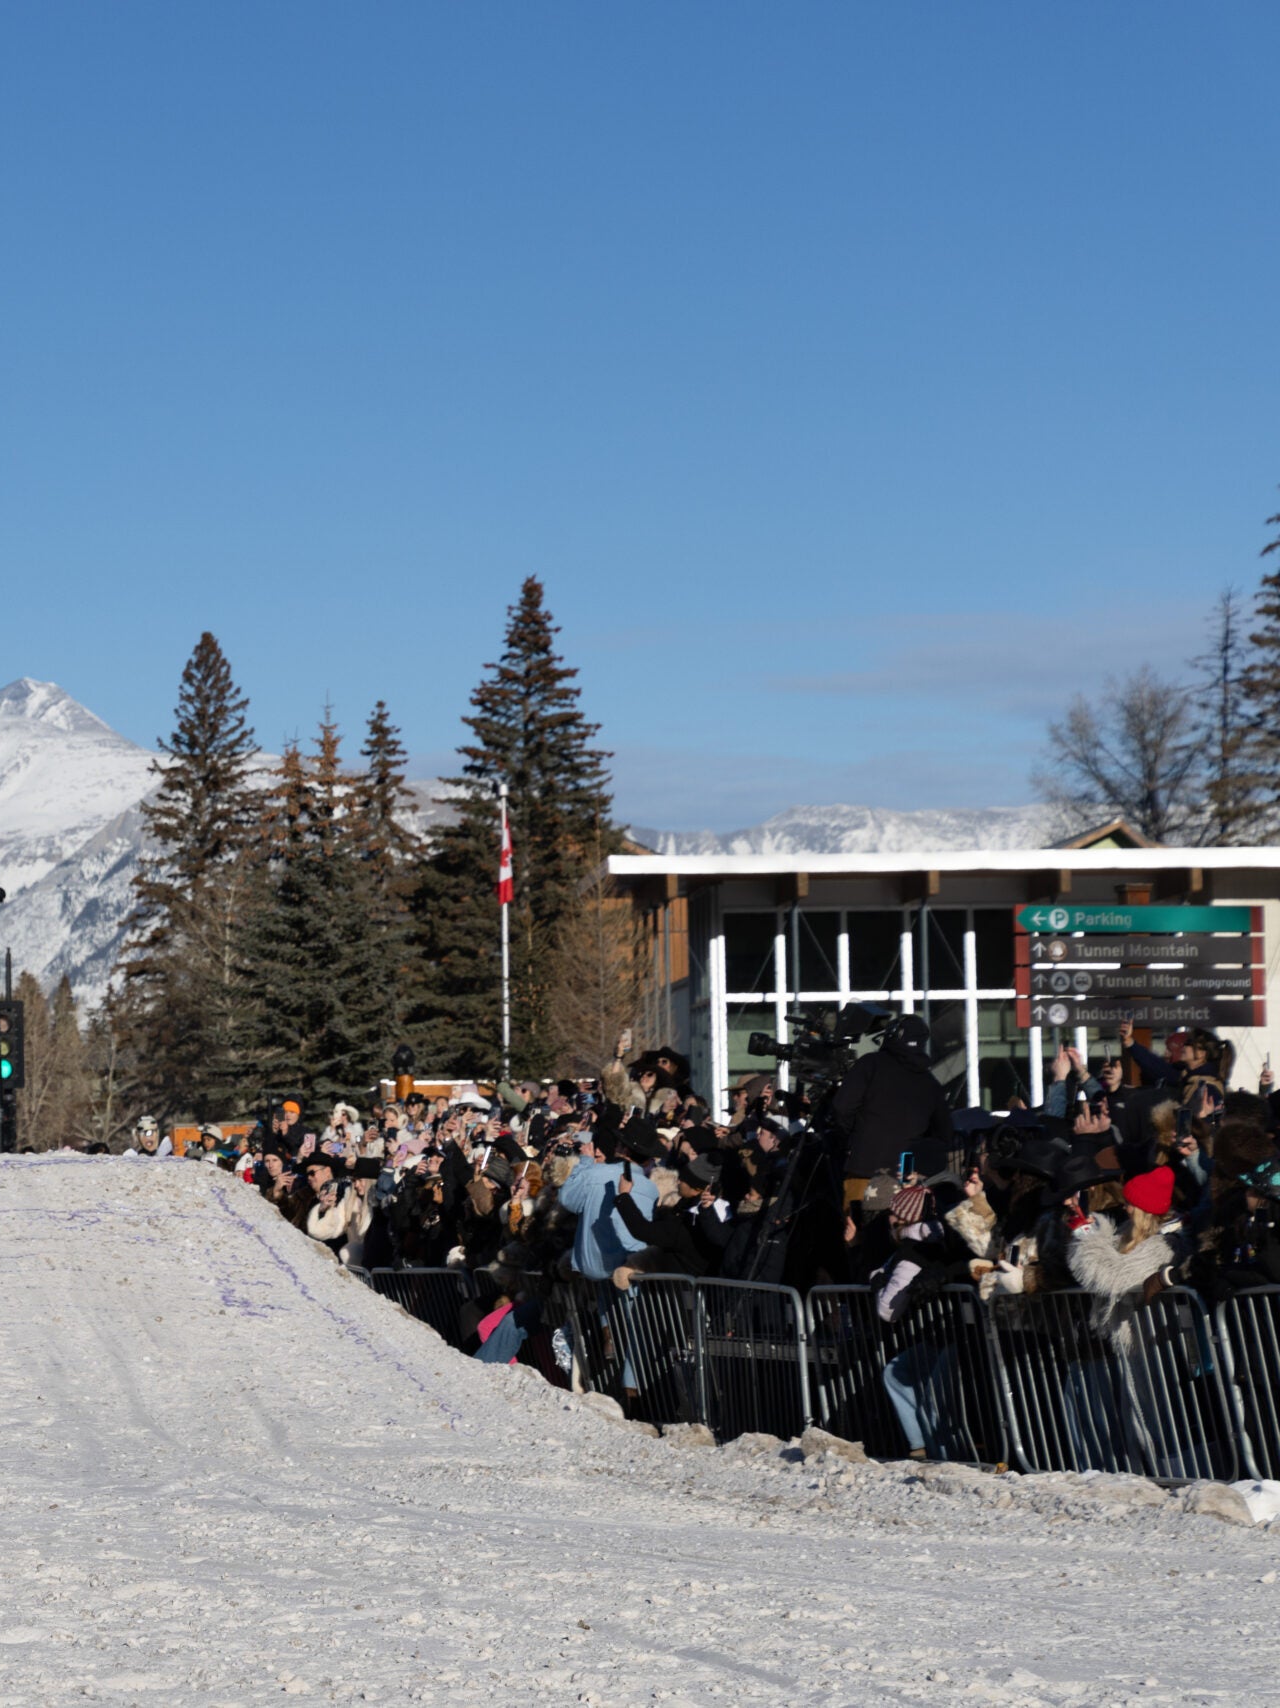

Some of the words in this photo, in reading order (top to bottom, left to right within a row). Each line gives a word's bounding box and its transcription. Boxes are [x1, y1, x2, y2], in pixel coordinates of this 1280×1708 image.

[1074, 912, 1133, 929] Parking
[1075, 943, 1125, 957] Tunnel
[1129, 943, 1199, 957] Mountain
[1096, 974, 1147, 988] Tunnel
[1151, 975, 1181, 988] Mtn
[1184, 977, 1251, 990] Campground
[1152, 1006, 1210, 1020] District
